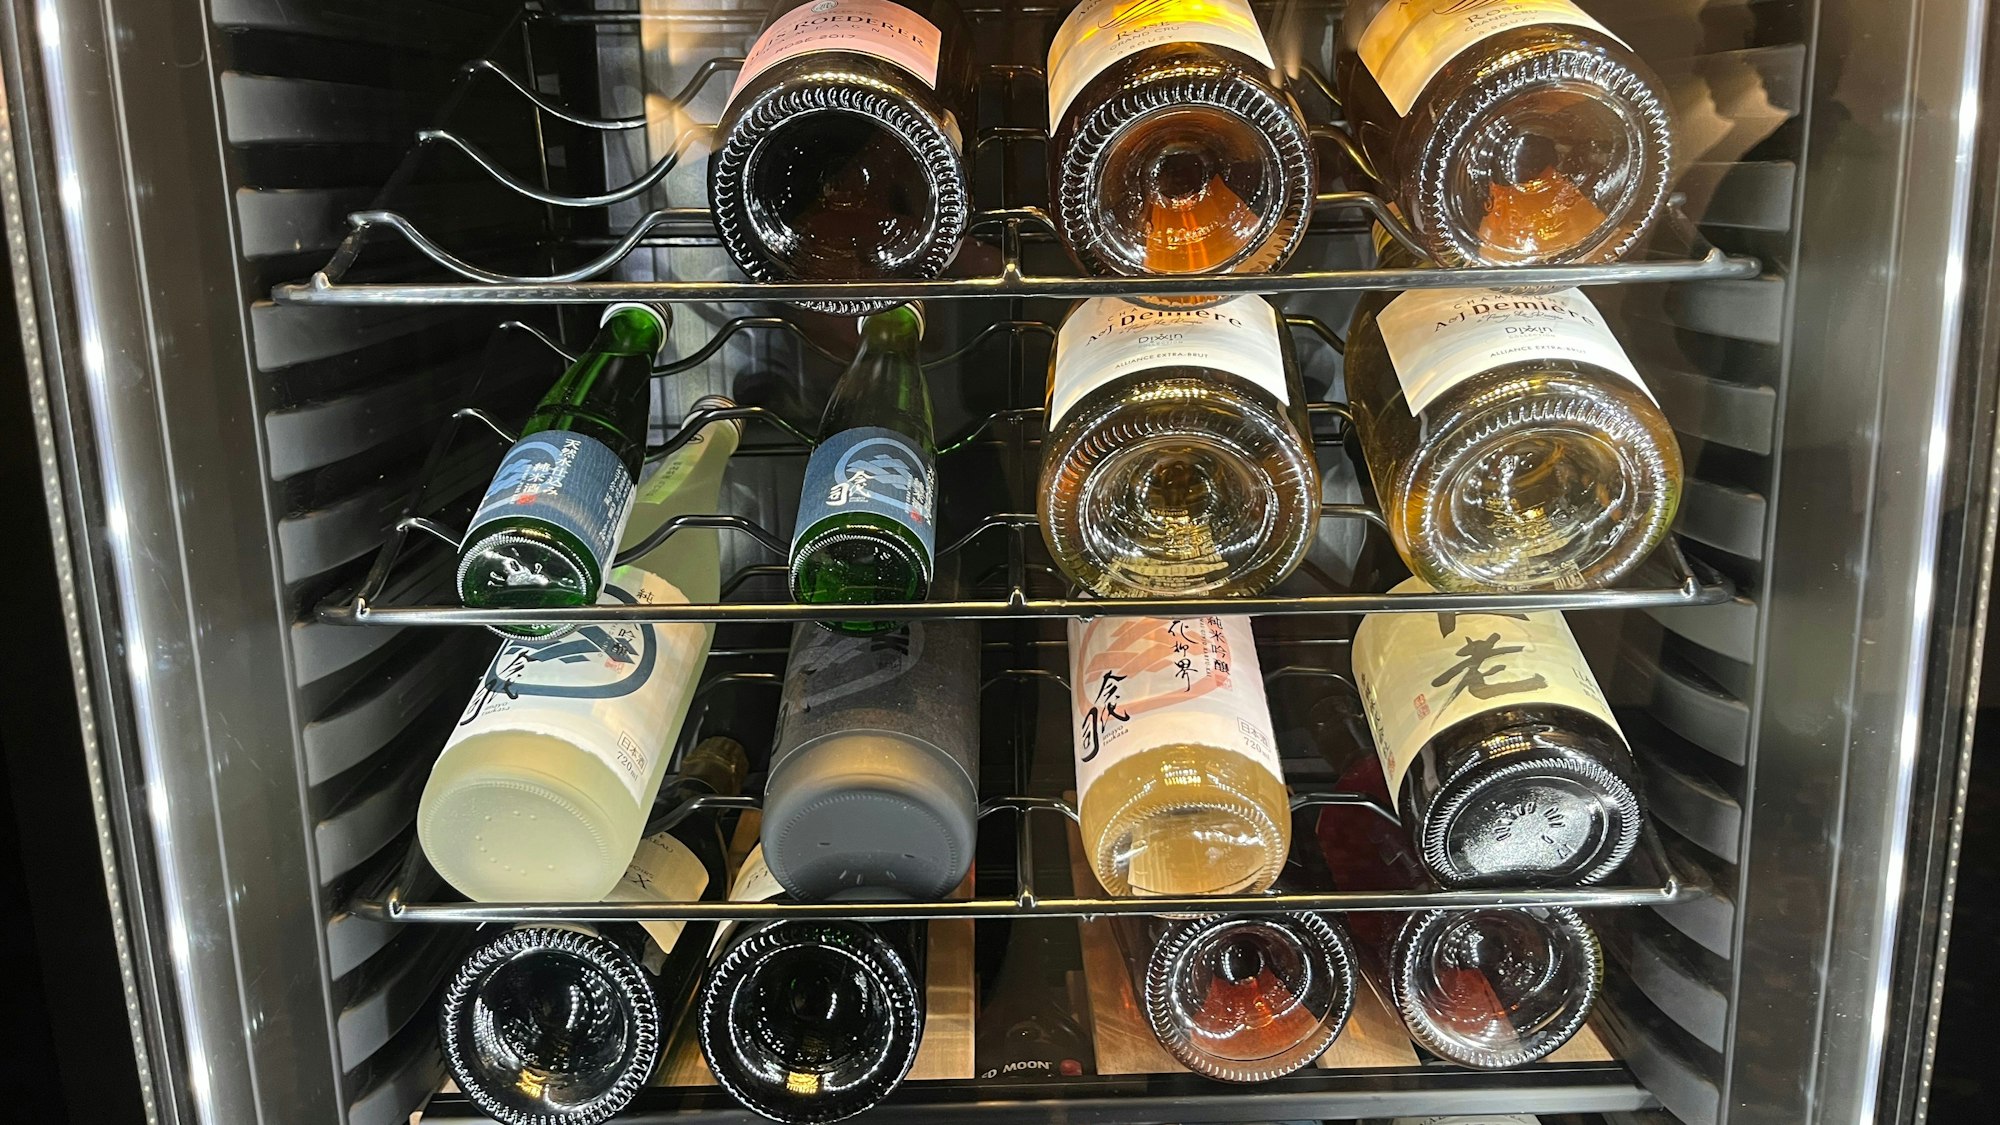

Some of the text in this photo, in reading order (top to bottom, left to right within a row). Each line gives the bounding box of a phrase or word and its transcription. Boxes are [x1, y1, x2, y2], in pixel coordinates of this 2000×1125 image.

[794, 15, 925, 47] ROEDERER
[1464, 14, 1508, 32] GRAND
[1109, 31, 1150, 51] GRAND
[1490, 345, 1533, 358] ALLIANCE
[1114, 354, 1154, 369] ALLIANCE
[620, 736, 647, 769] 日本酒
[1002, 1060, 1050, 1073] MOON
